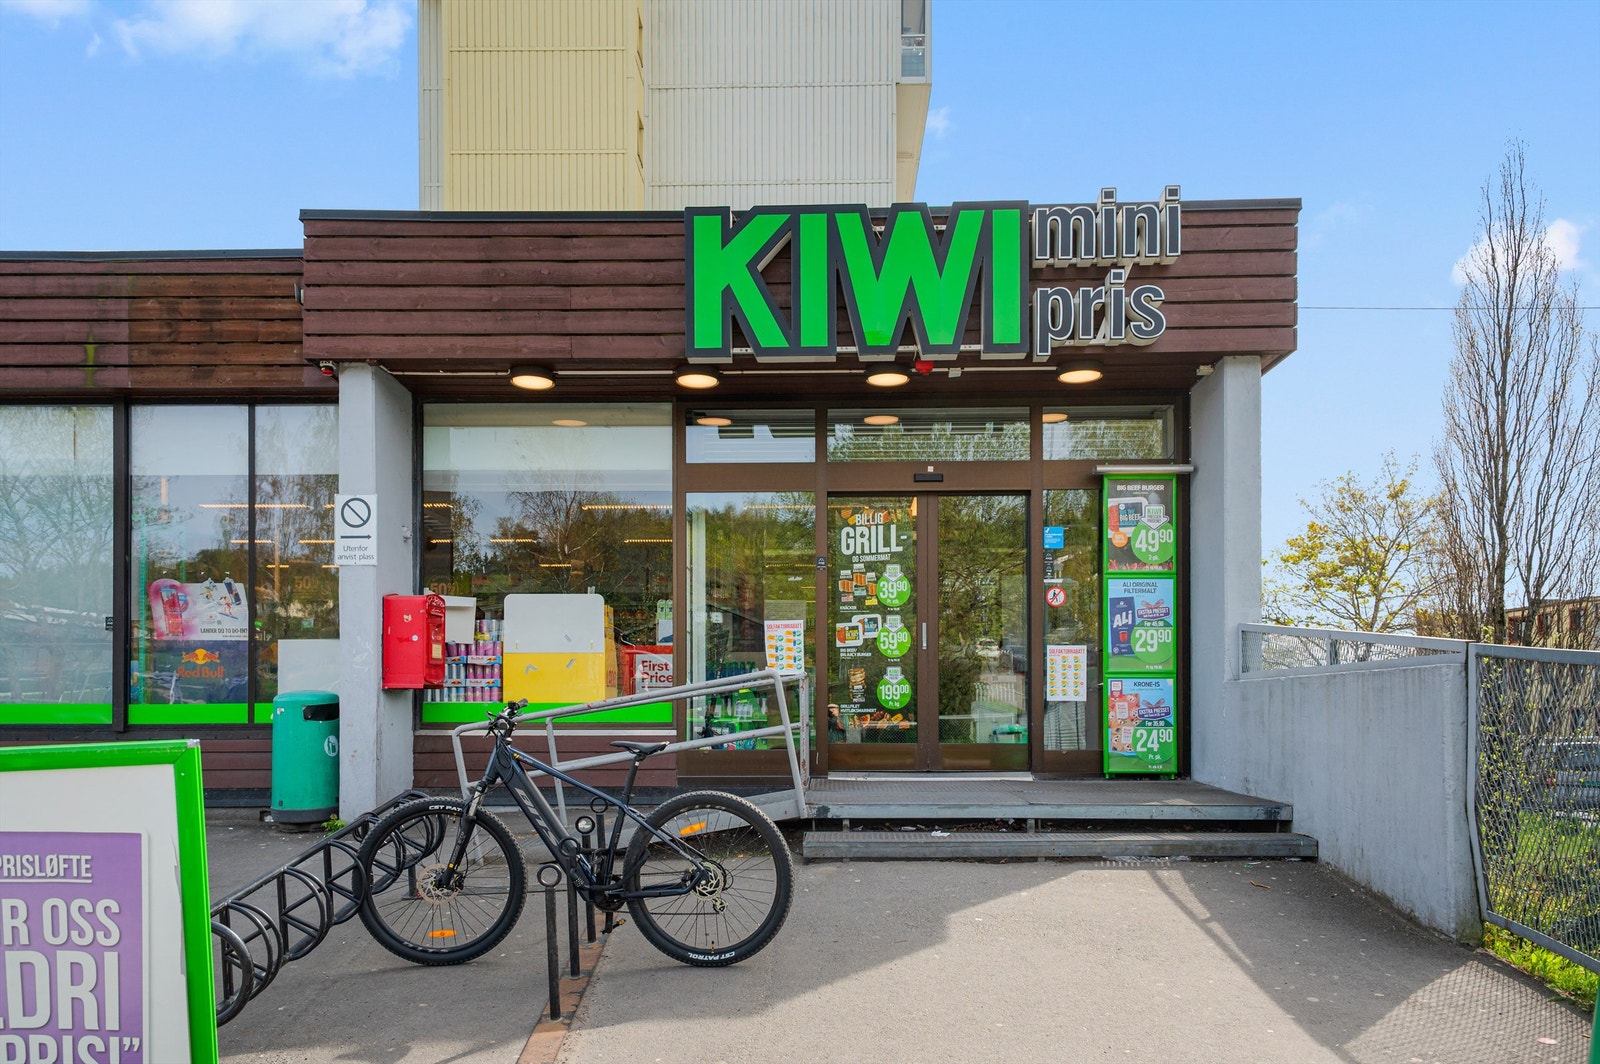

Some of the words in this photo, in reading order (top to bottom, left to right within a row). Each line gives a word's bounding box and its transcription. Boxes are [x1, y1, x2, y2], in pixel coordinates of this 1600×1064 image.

[1033, 185, 1182, 266] mini
[687, 203, 1028, 358] KIWI
[1033, 268, 1167, 361] pris
[855, 512, 883, 525] BILLIG
[337, 553, 357, 561] anvist
[358, 553, 375, 562] plass
[177, 666, 200, 678] Red
[201, 665, 225, 678] Bull
[641, 660, 670, 671] First
[641, 671, 674, 683] Price
[0, 853, 93, 878] RISLØFTE
[42, 897, 121, 947] OSS
[687, 952, 719, 961] PATROL
[0, 950, 120, 1031] DRI
